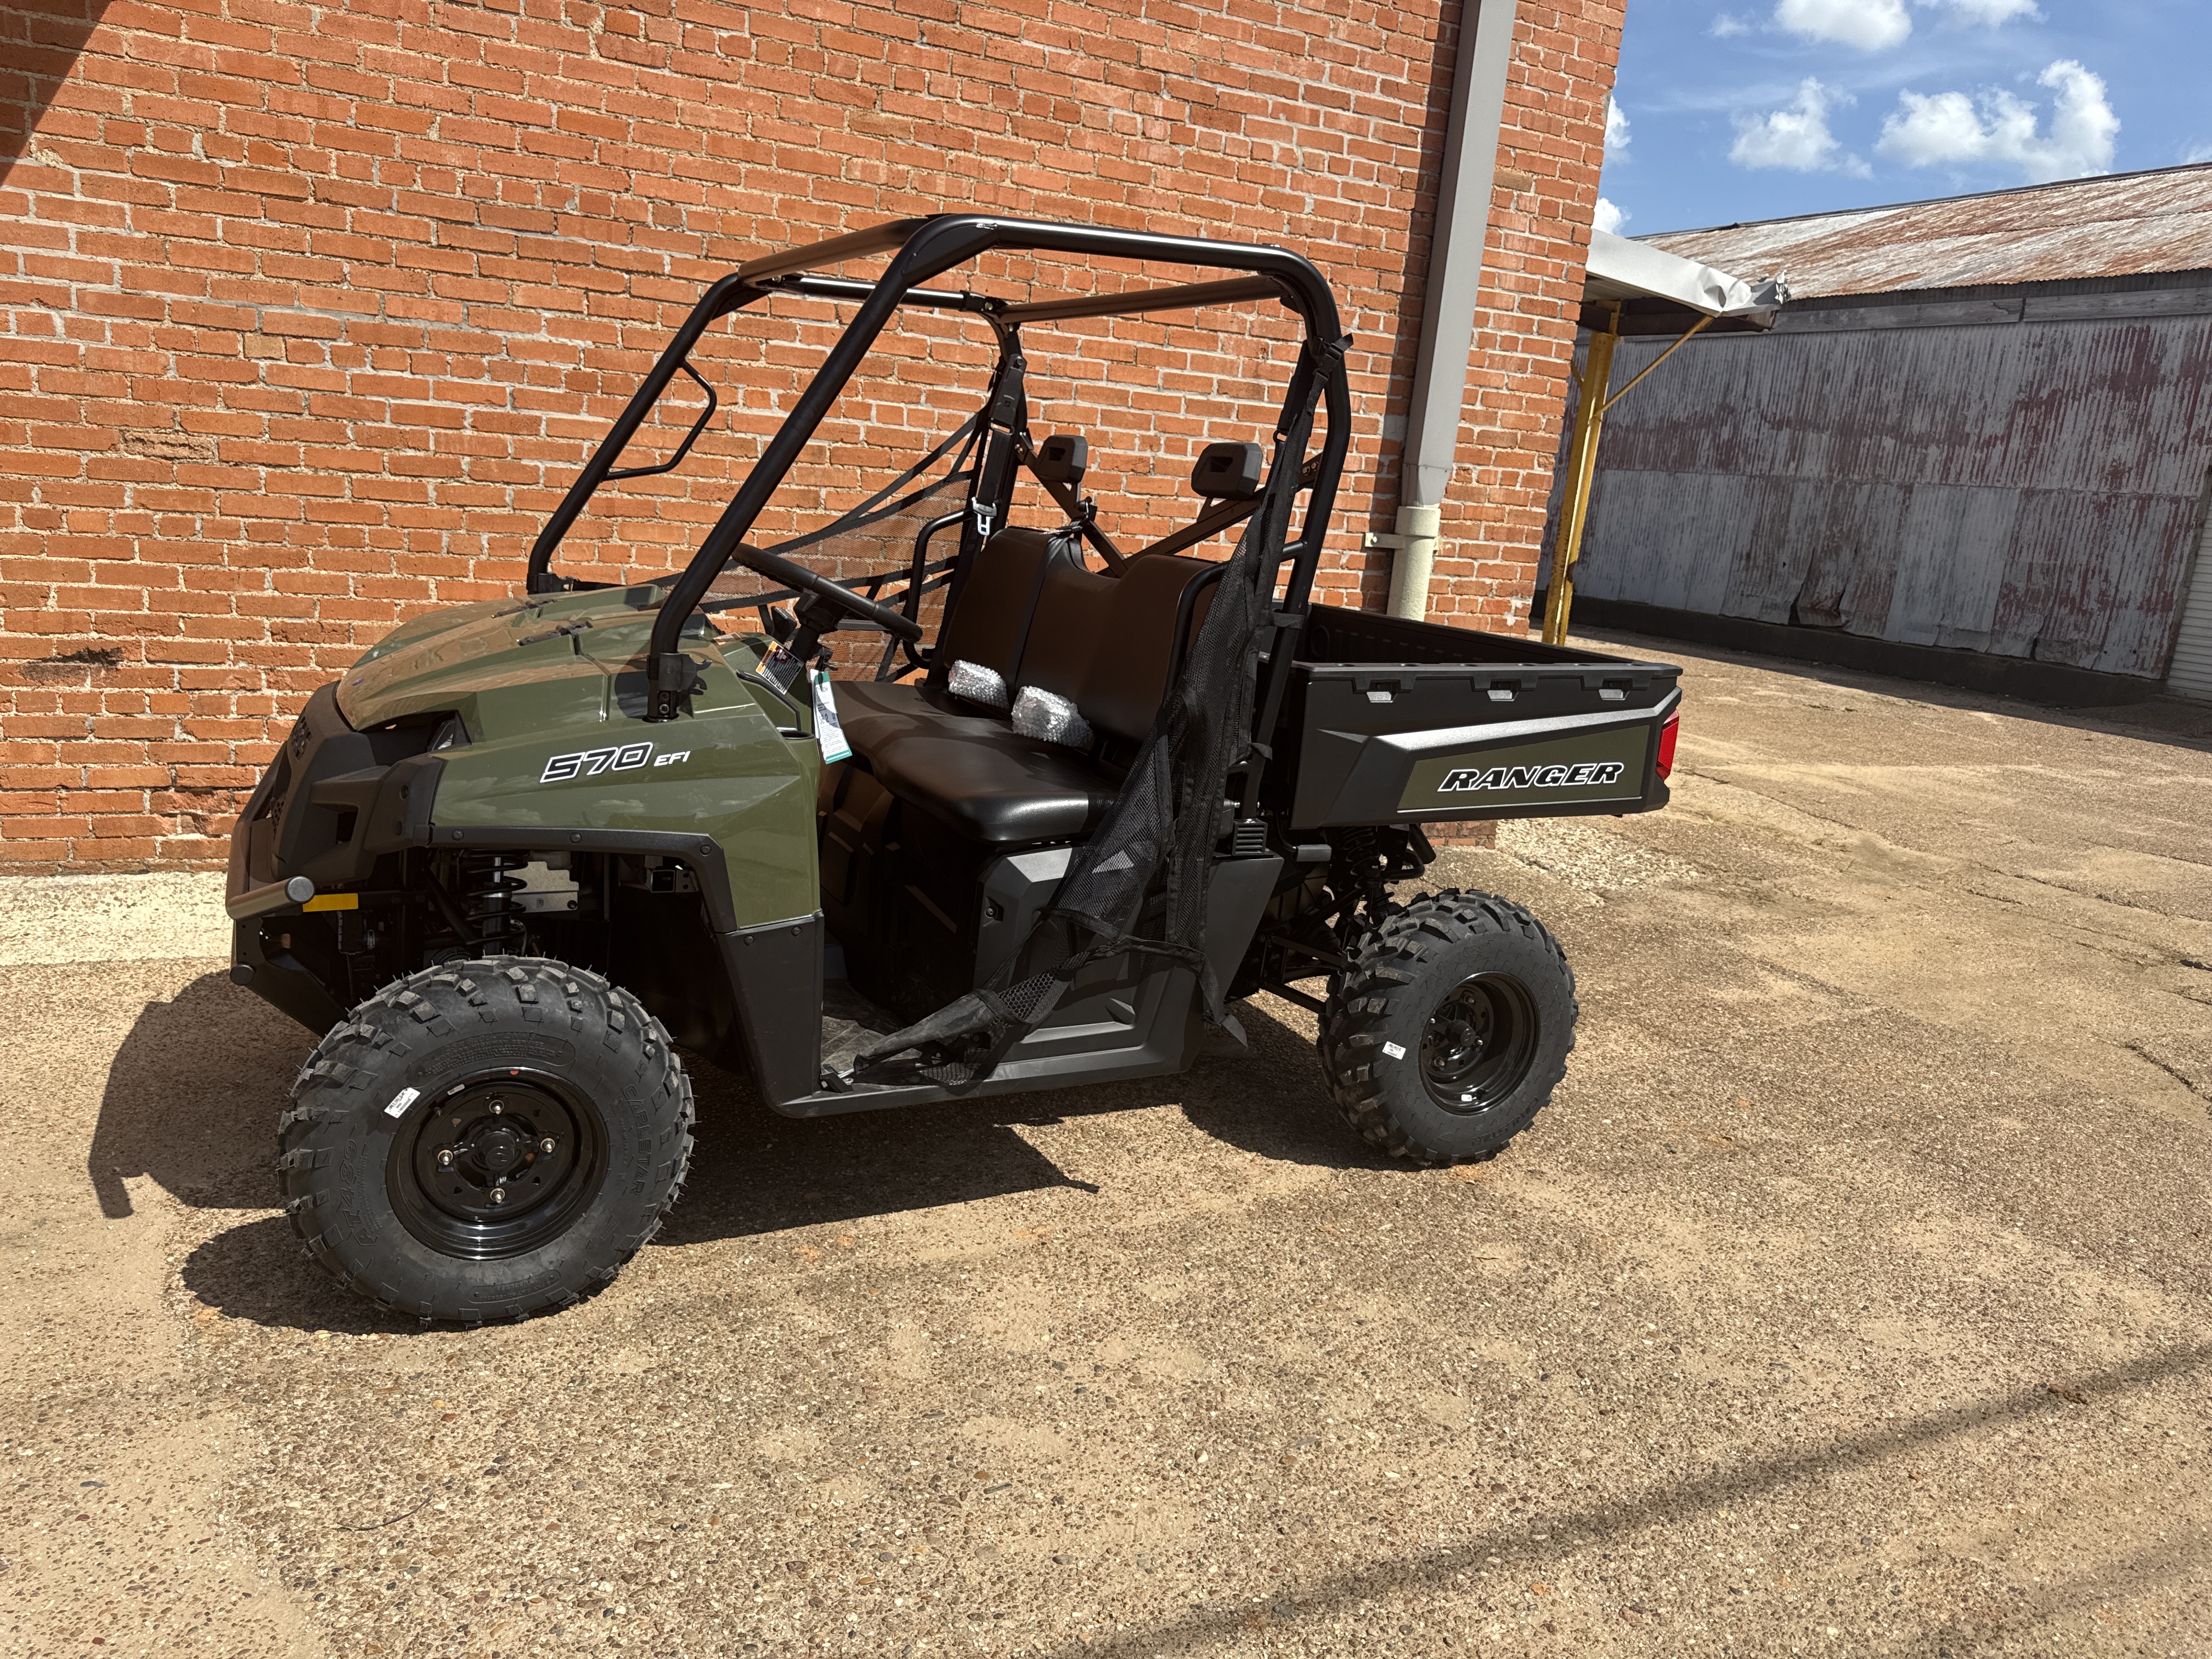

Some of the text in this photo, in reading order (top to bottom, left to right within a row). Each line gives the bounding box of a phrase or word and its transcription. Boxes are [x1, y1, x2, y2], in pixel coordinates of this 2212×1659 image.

[540, 742, 692, 783] 570 EFI
[1437, 762, 1624, 792] RANGER
[622, 1084, 652, 1195] CARLSTAR
[1471, 1097, 1539, 1147] CARLSTAR
